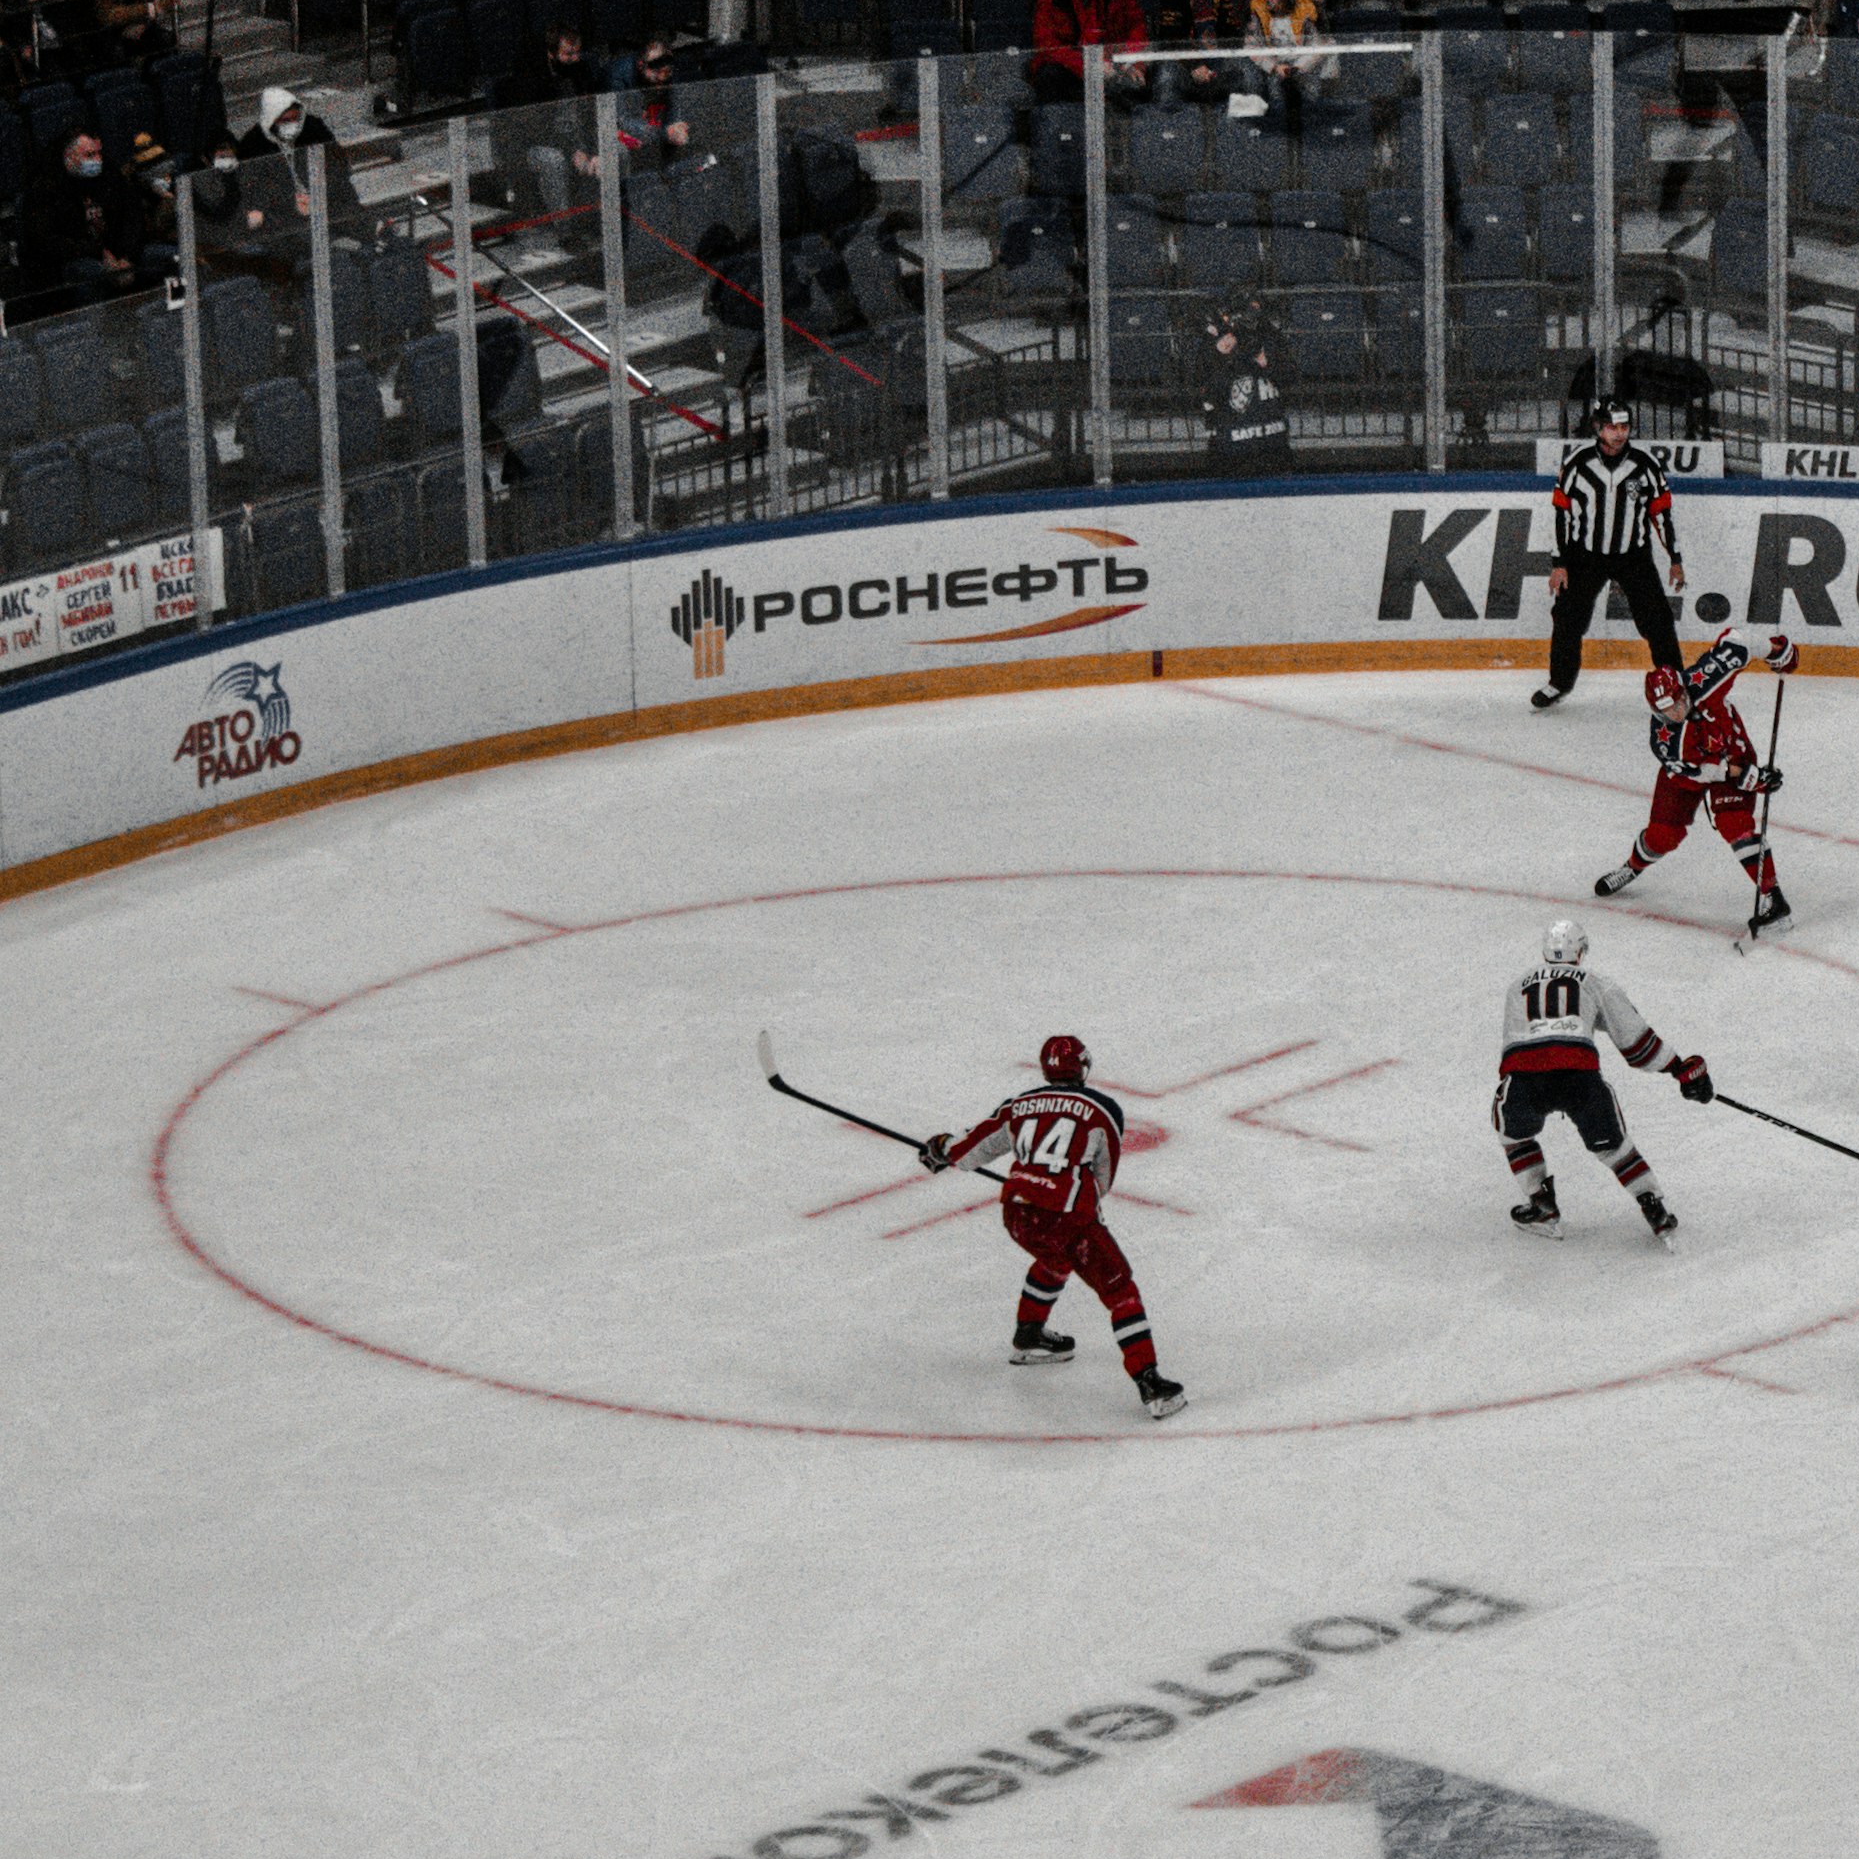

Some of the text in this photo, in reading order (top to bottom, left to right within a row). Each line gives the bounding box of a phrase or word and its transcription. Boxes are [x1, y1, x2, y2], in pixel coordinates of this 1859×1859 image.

[753, 557, 1149, 632] РОСНЕФТЬ
[173, 710, 252, 763] АВТО
[197, 730, 300, 788] РАДИО
[1520, 976, 1581, 1023] 10
[1521, 968, 1587, 988] GALUZIN
[1011, 1097, 1096, 1122] SOSHNIKOV
